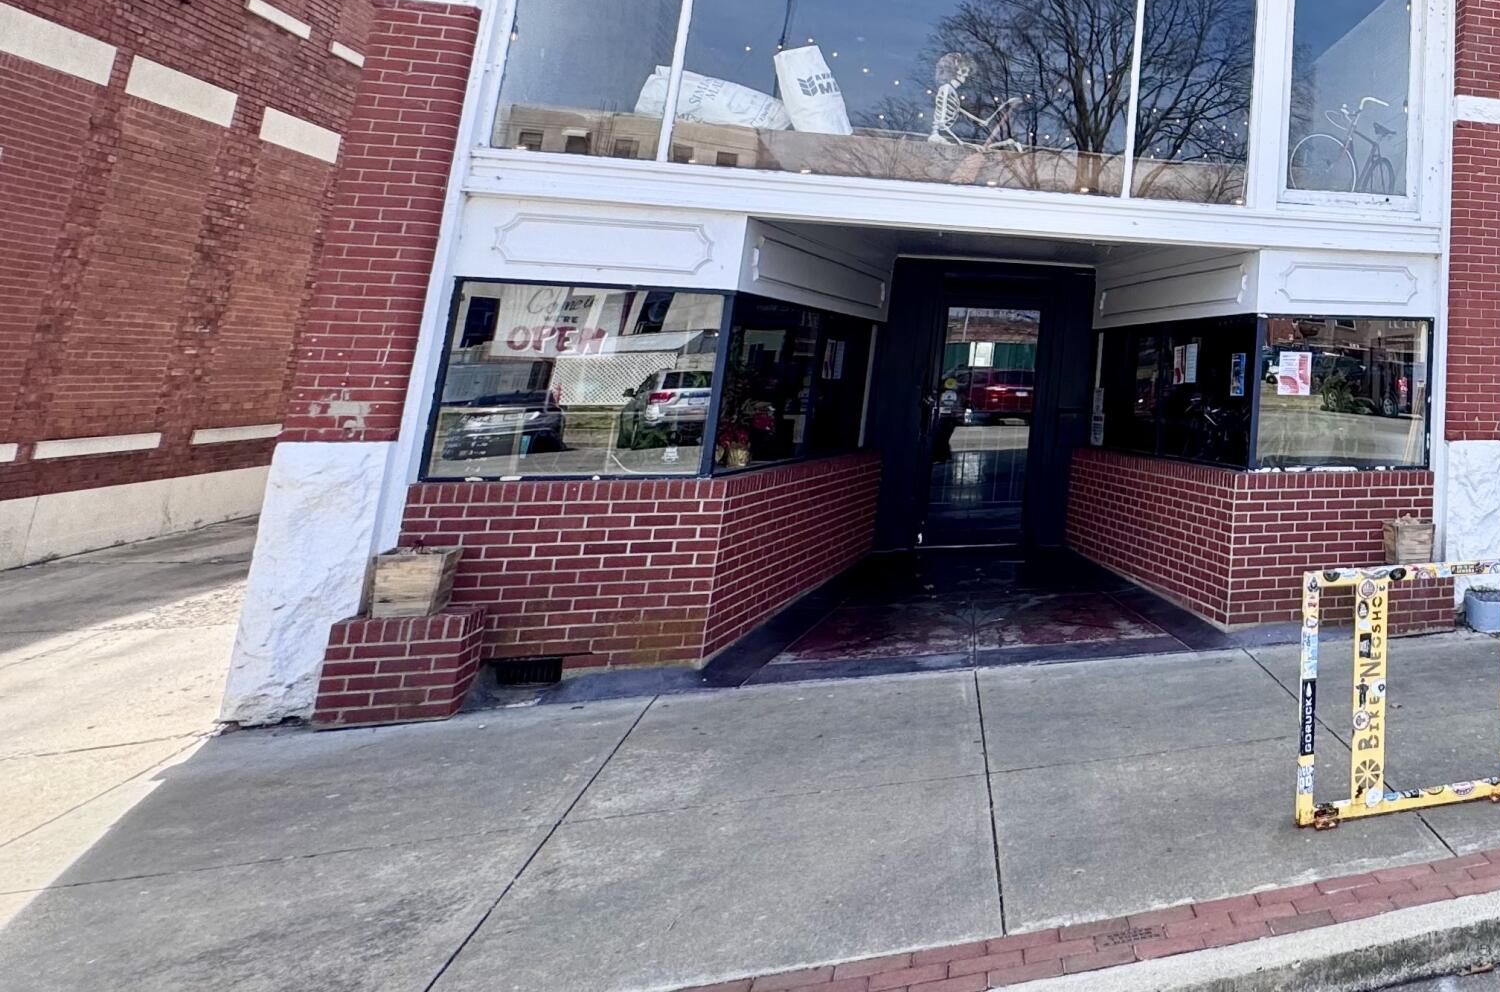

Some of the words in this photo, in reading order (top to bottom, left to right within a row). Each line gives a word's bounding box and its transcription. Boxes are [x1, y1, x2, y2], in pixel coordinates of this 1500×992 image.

[506, 325, 609, 356] OPEN
[1304, 696, 1313, 753] GORUCK
[1358, 695, 1380, 752] BIKE
